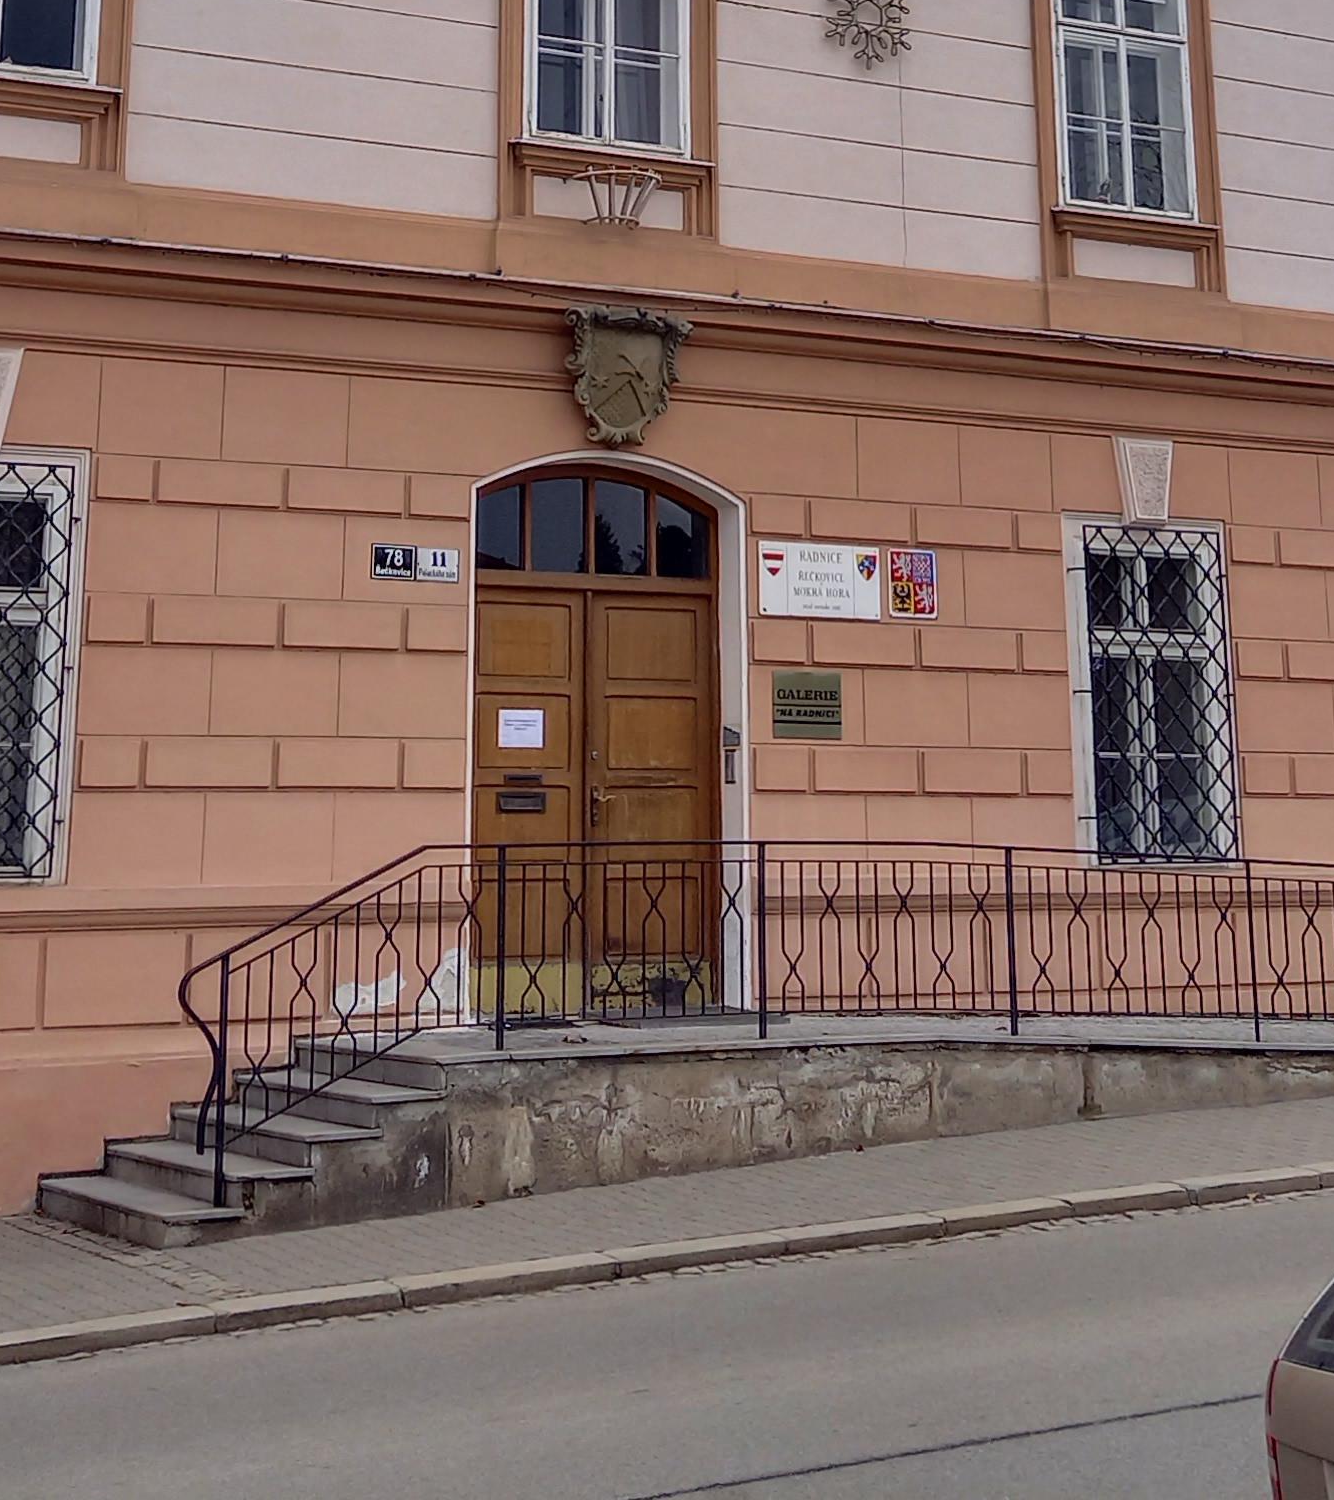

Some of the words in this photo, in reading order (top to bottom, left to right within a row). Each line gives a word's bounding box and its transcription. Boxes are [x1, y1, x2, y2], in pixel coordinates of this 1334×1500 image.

[384, 549, 404, 566] 78
[431, 551, 446, 567] 11
[799, 550, 842, 564] RADNICE
[826, 587, 850, 599] HORA
[777, 689, 838, 701] GALERIE
